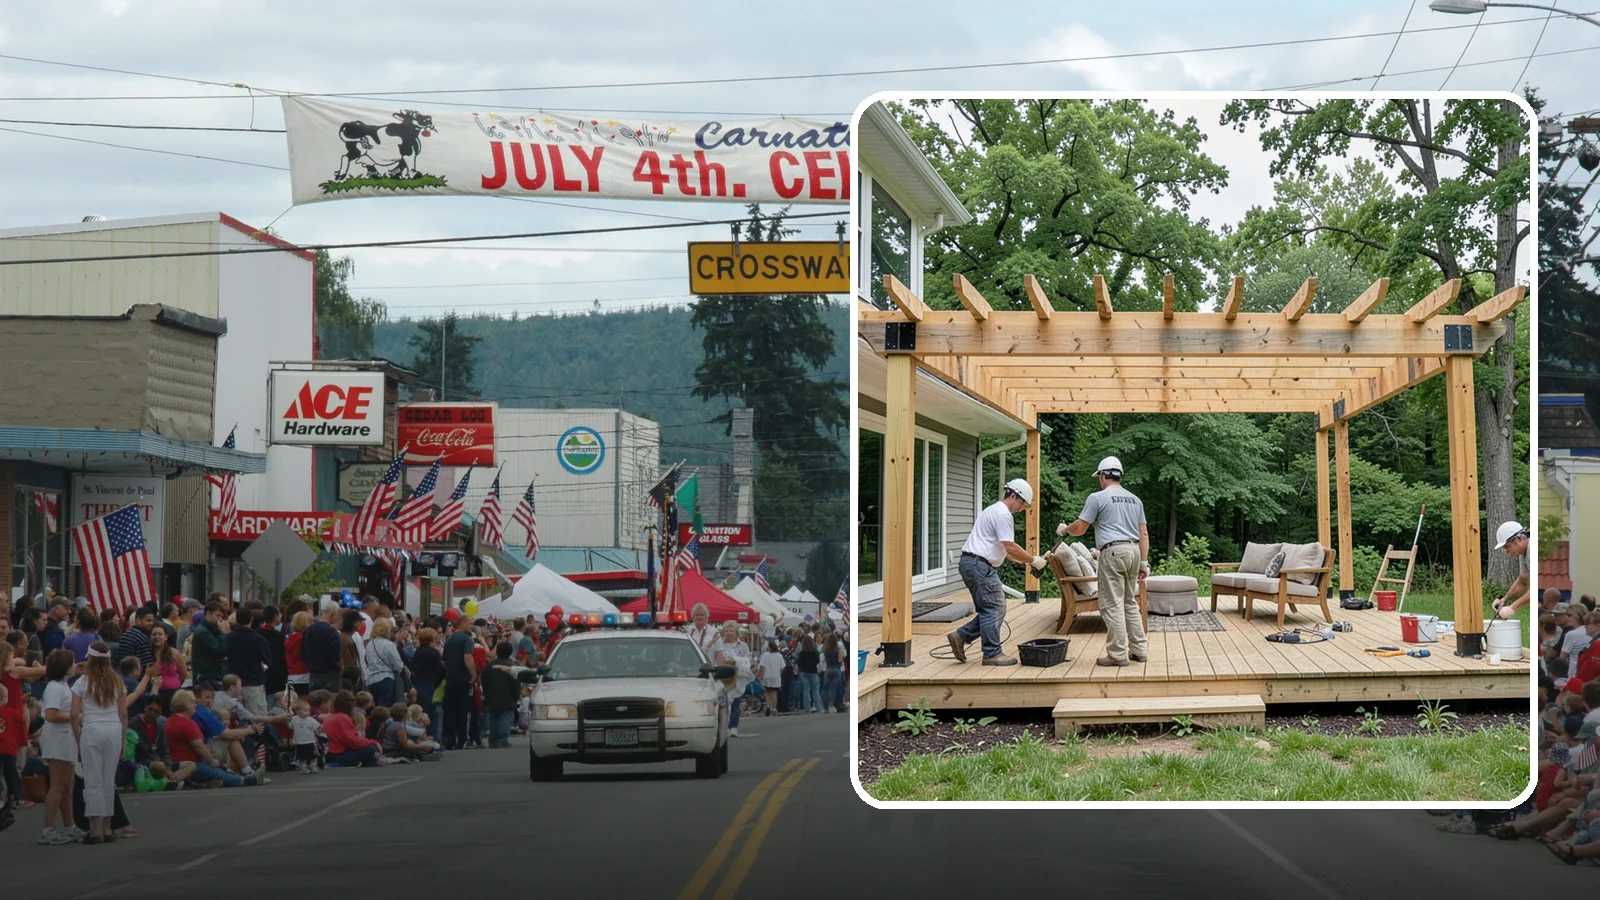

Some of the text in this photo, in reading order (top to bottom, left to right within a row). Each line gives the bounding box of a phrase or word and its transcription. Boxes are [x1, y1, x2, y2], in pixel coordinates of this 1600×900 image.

[481, 142, 604, 193] JULY
[632, 149, 746, 198] 4th.
[696, 253, 850, 281] CROSSWA
[283, 380, 373, 420] ACE
[406, 409, 452, 422] CEDAR
[283, 421, 371, 436] Hardware
[416, 428, 477, 447] Coca-Cola
[353, 467, 385, 480] Simpl
[83, 485, 155, 495] St. Vincent de Paul
[81, 503, 154, 522] THT
[213, 516, 330, 535] HARDARE
[688, 526, 741, 535] CRNATION
[699, 535, 730, 543] GLASS
